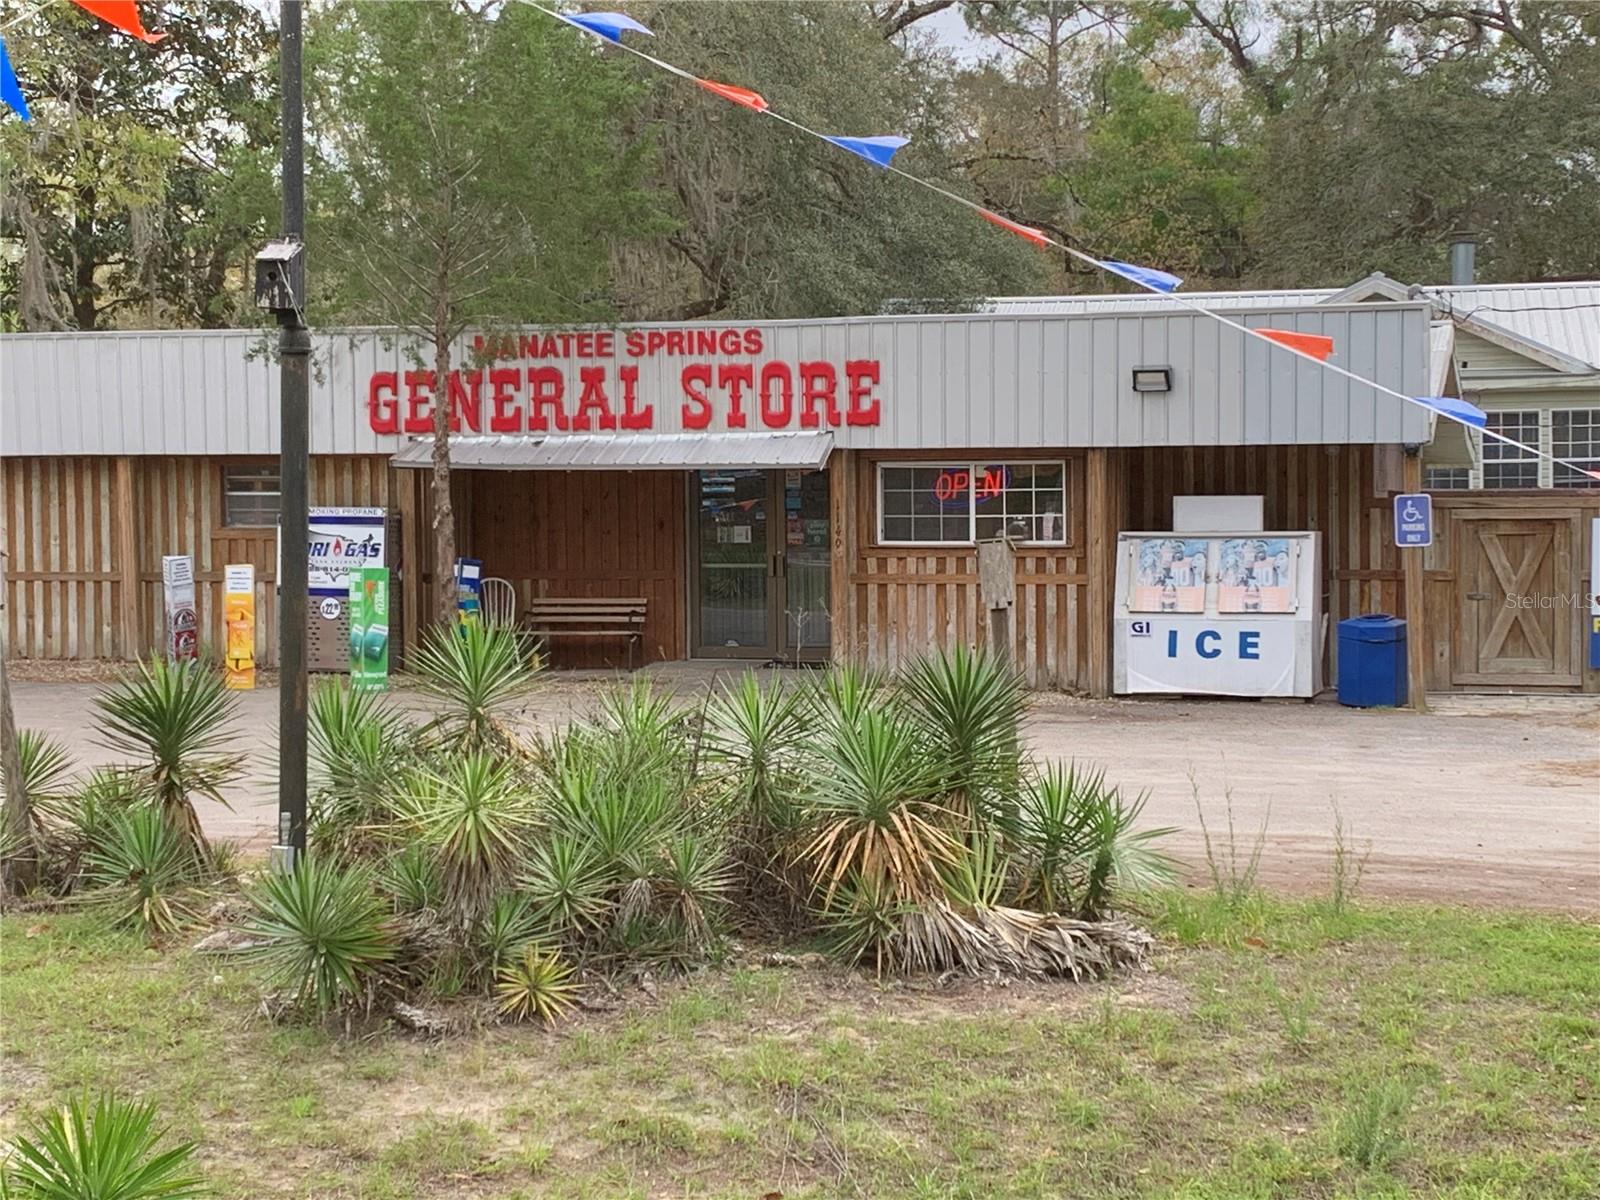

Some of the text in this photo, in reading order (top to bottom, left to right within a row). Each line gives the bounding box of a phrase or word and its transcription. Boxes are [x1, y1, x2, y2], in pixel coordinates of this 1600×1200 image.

[474, 328, 764, 359] MANATEE SPRINGS
[368, 359, 881, 436] GENERAL STORE
[935, 469, 1001, 500] OPEN
[308, 542, 382, 558] RI GAS
[1131, 621, 1150, 634] GI
[1167, 629, 1261, 660] ICE
